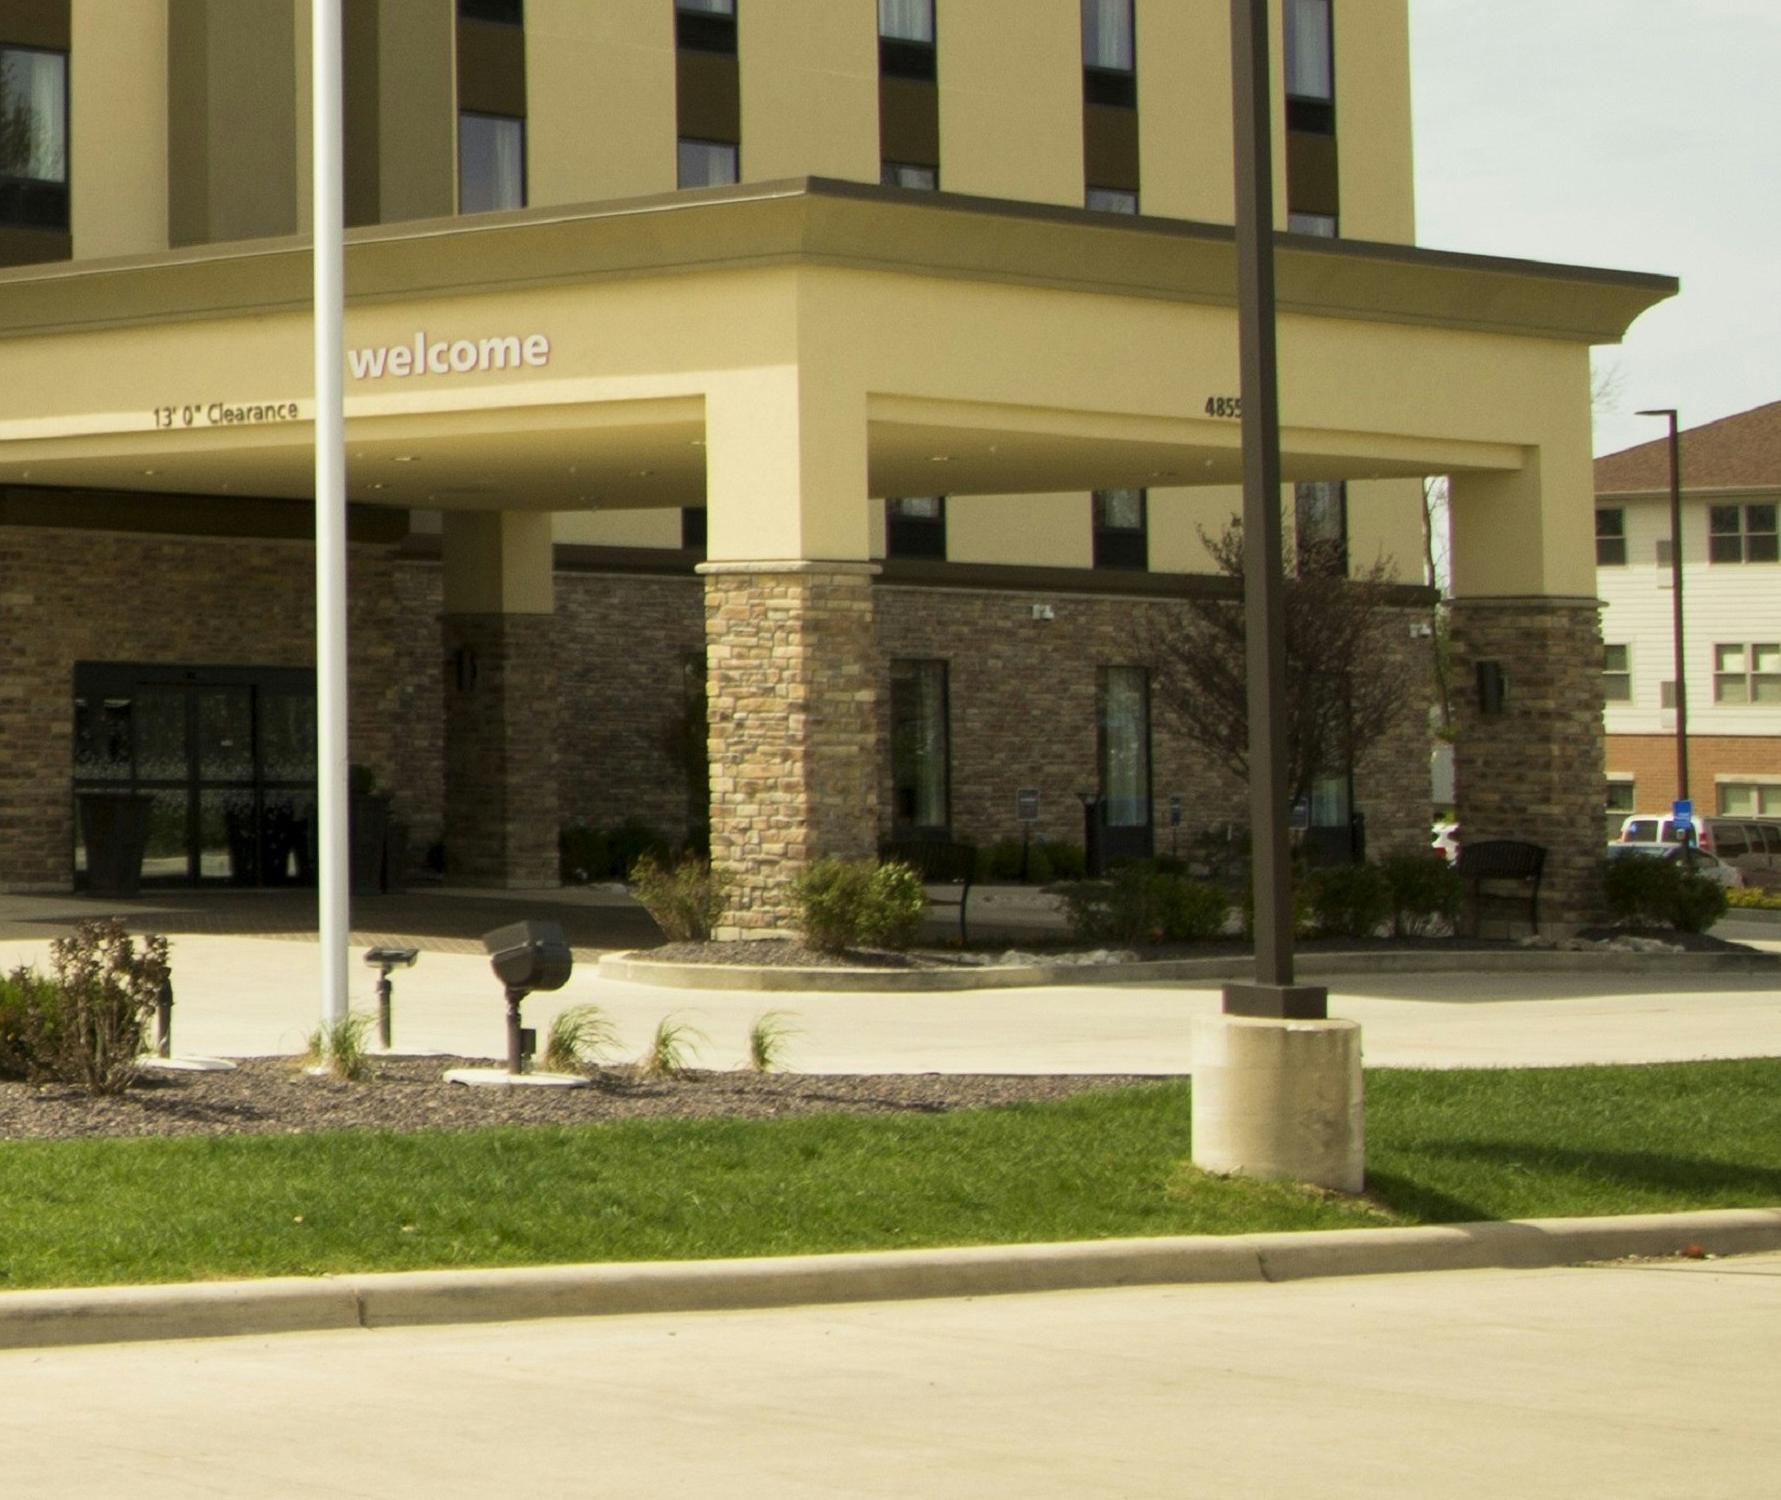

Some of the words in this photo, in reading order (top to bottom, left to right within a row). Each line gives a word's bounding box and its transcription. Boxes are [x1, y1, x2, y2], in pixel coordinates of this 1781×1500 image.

[348, 332, 551, 380] welcome
[207, 402, 299, 425] Clearance
[1205, 396, 1241, 419] 4855
